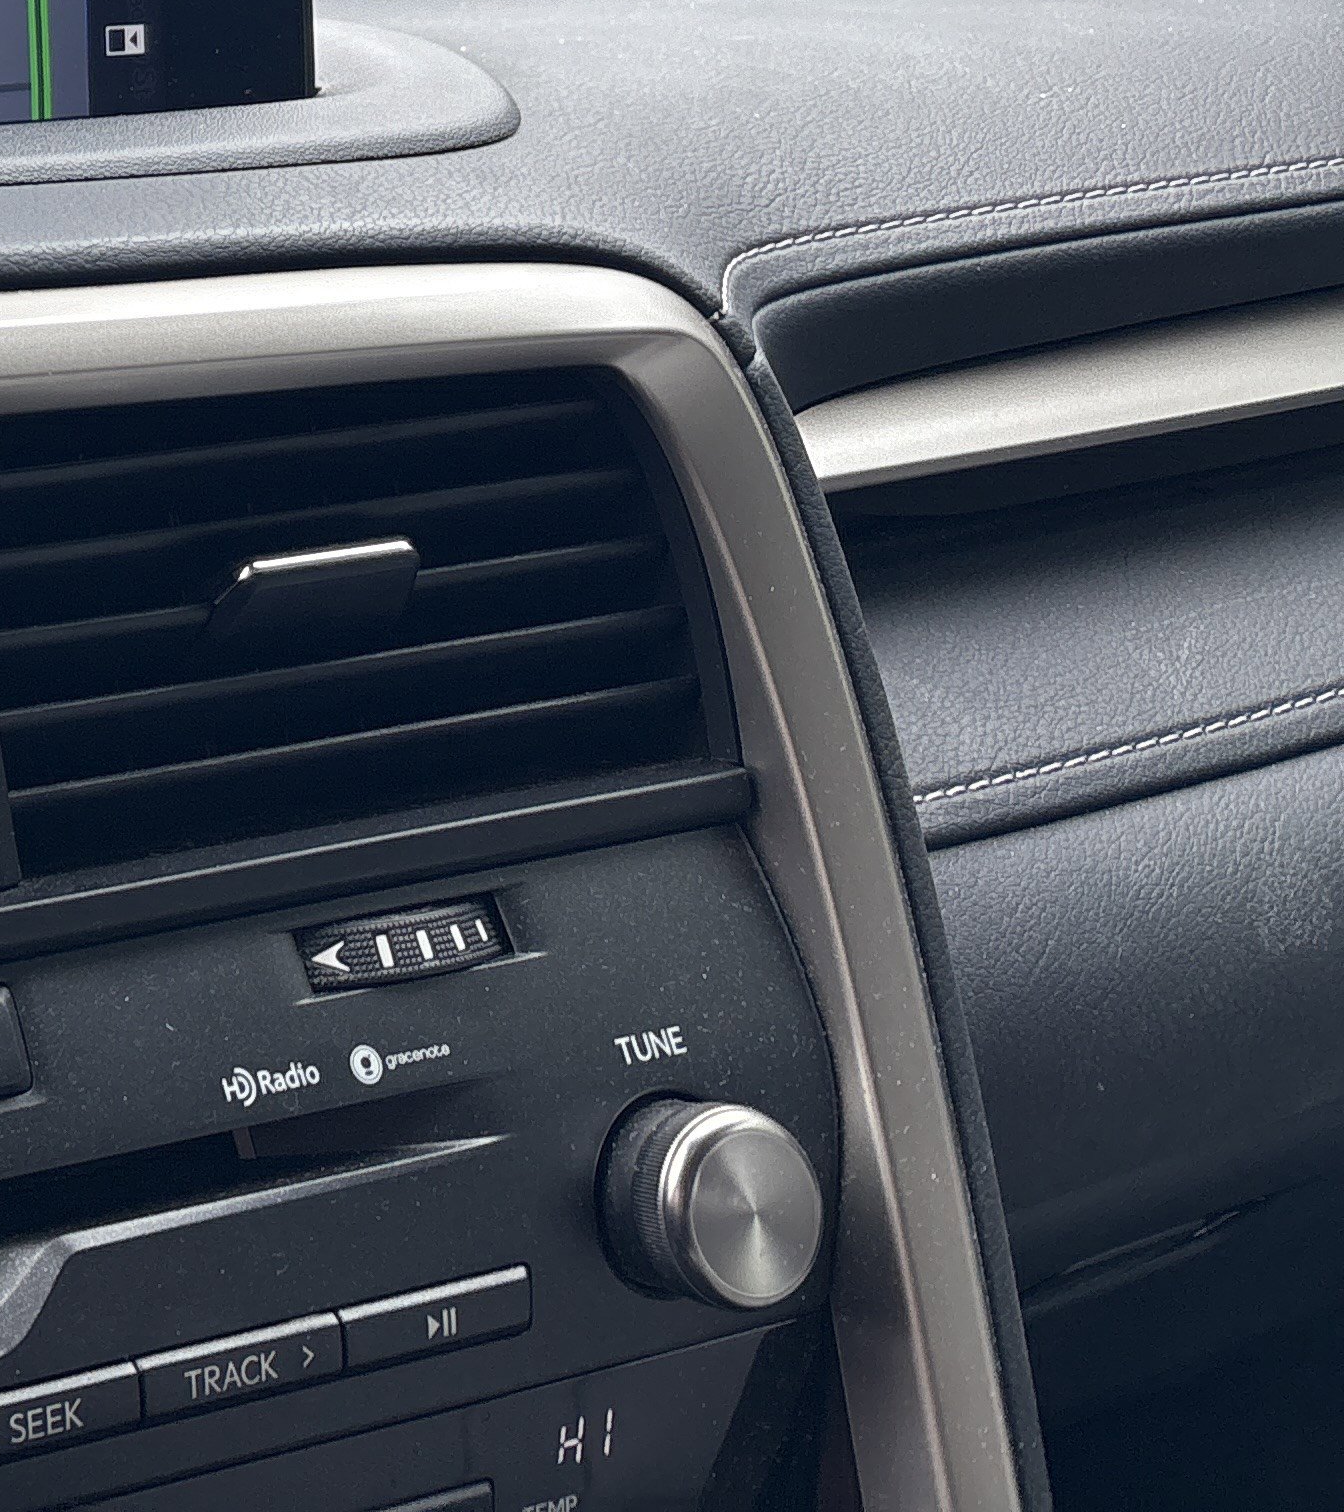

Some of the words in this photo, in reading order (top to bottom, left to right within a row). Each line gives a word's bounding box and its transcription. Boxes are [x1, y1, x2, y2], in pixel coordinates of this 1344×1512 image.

[614, 1025, 687, 1066] TUNE
[258, 1061, 320, 1096] Radio
[183, 1354, 279, 1400] TRACK
[9, 1398, 83, 1445] SEEK
[557, 1407, 613, 1464] HI
